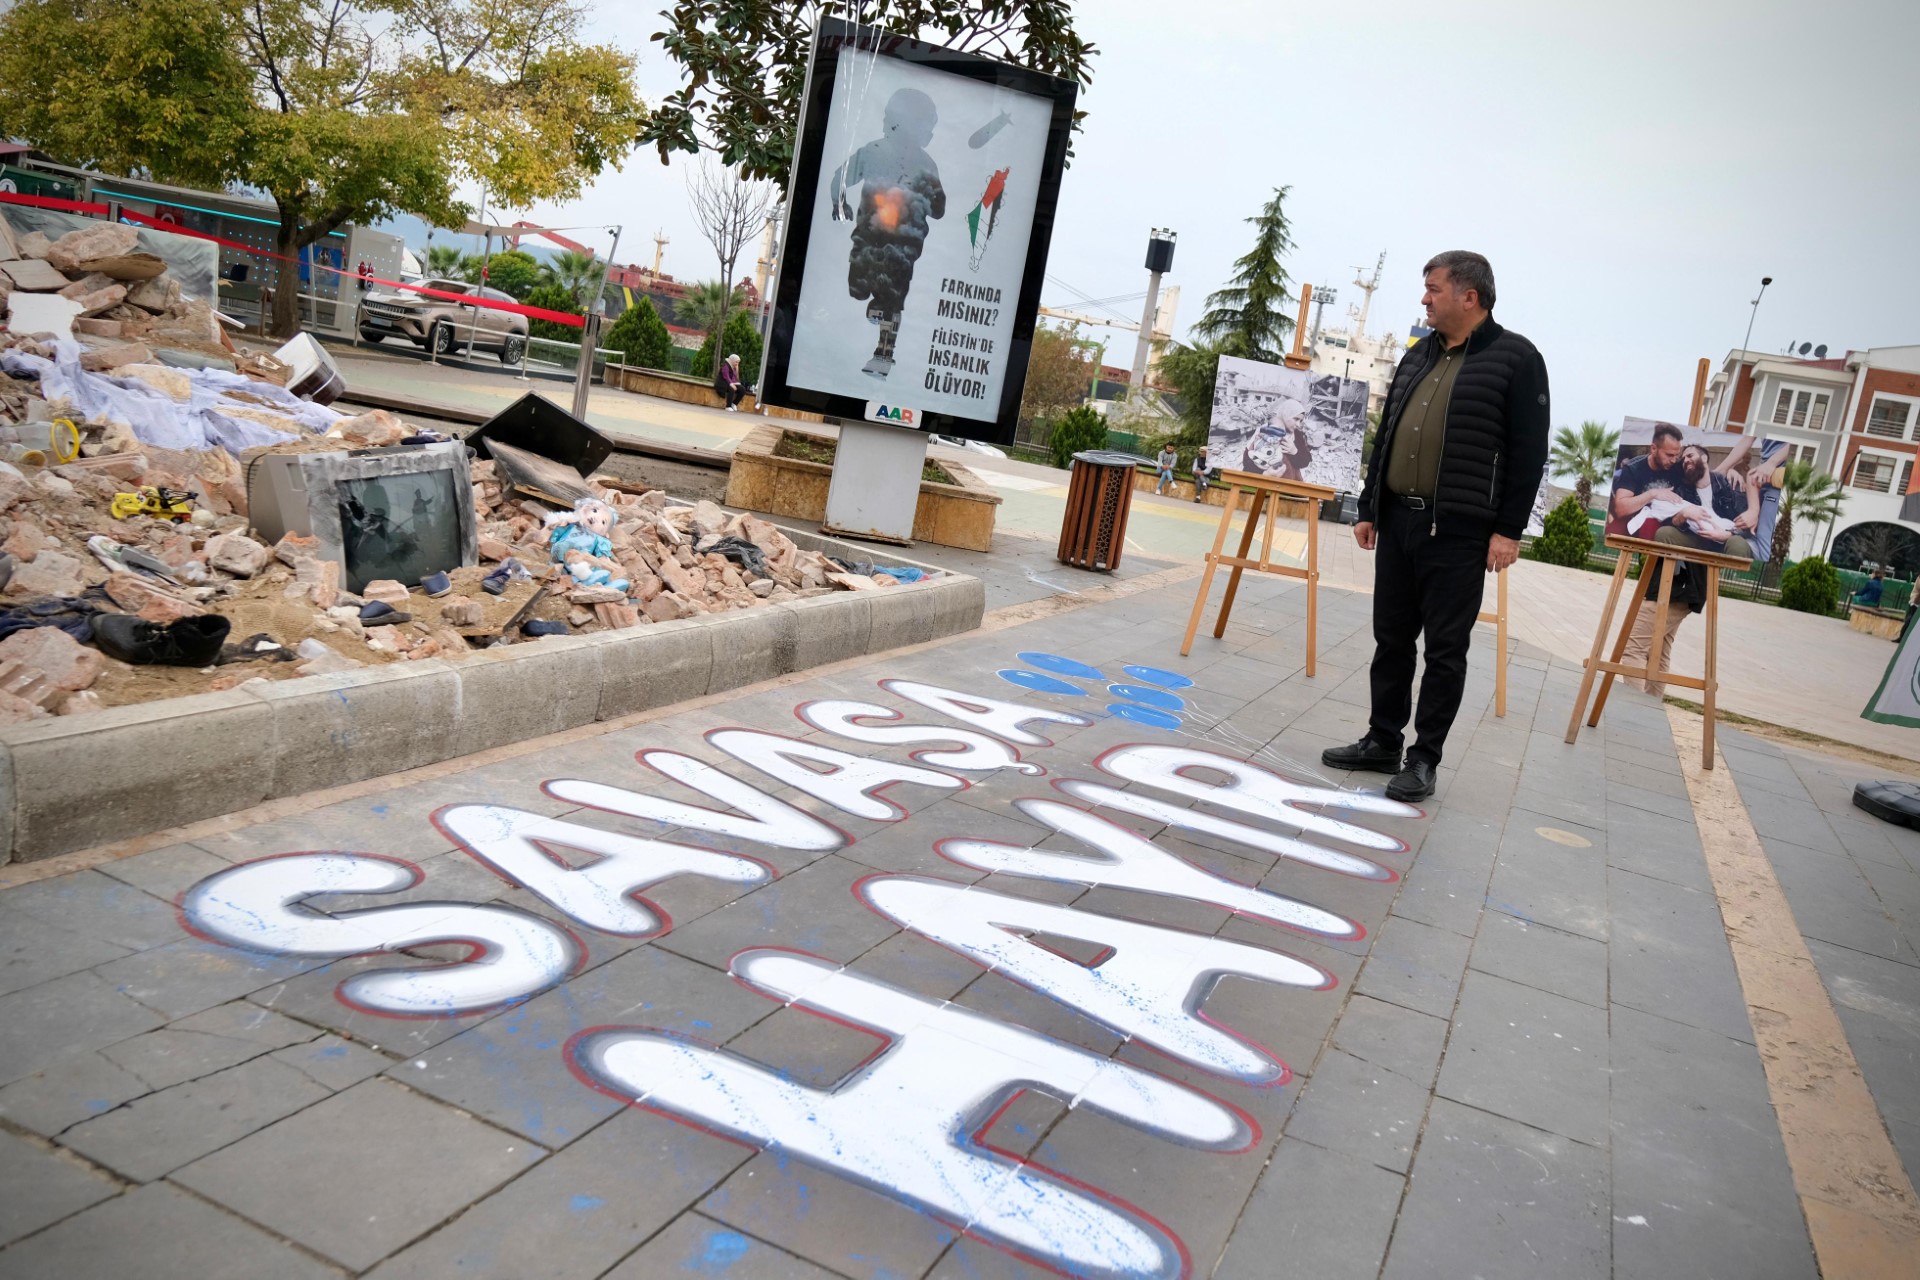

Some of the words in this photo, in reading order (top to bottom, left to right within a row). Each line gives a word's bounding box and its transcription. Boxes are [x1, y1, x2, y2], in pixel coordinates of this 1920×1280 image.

[941, 278, 1001, 304] FARKINDA
[937, 299, 999, 327] MISINIZ?
[932, 327, 994, 354] FİLİSTİN'DE
[928, 345, 990, 375] İNSANLIK
[924, 368, 986, 400] ÖLÜYOR!
[876, 404, 913, 424] AAR
[175, 679, 1094, 1019] SAVAŞA
[564, 743, 1425, 1280] HAYIR
